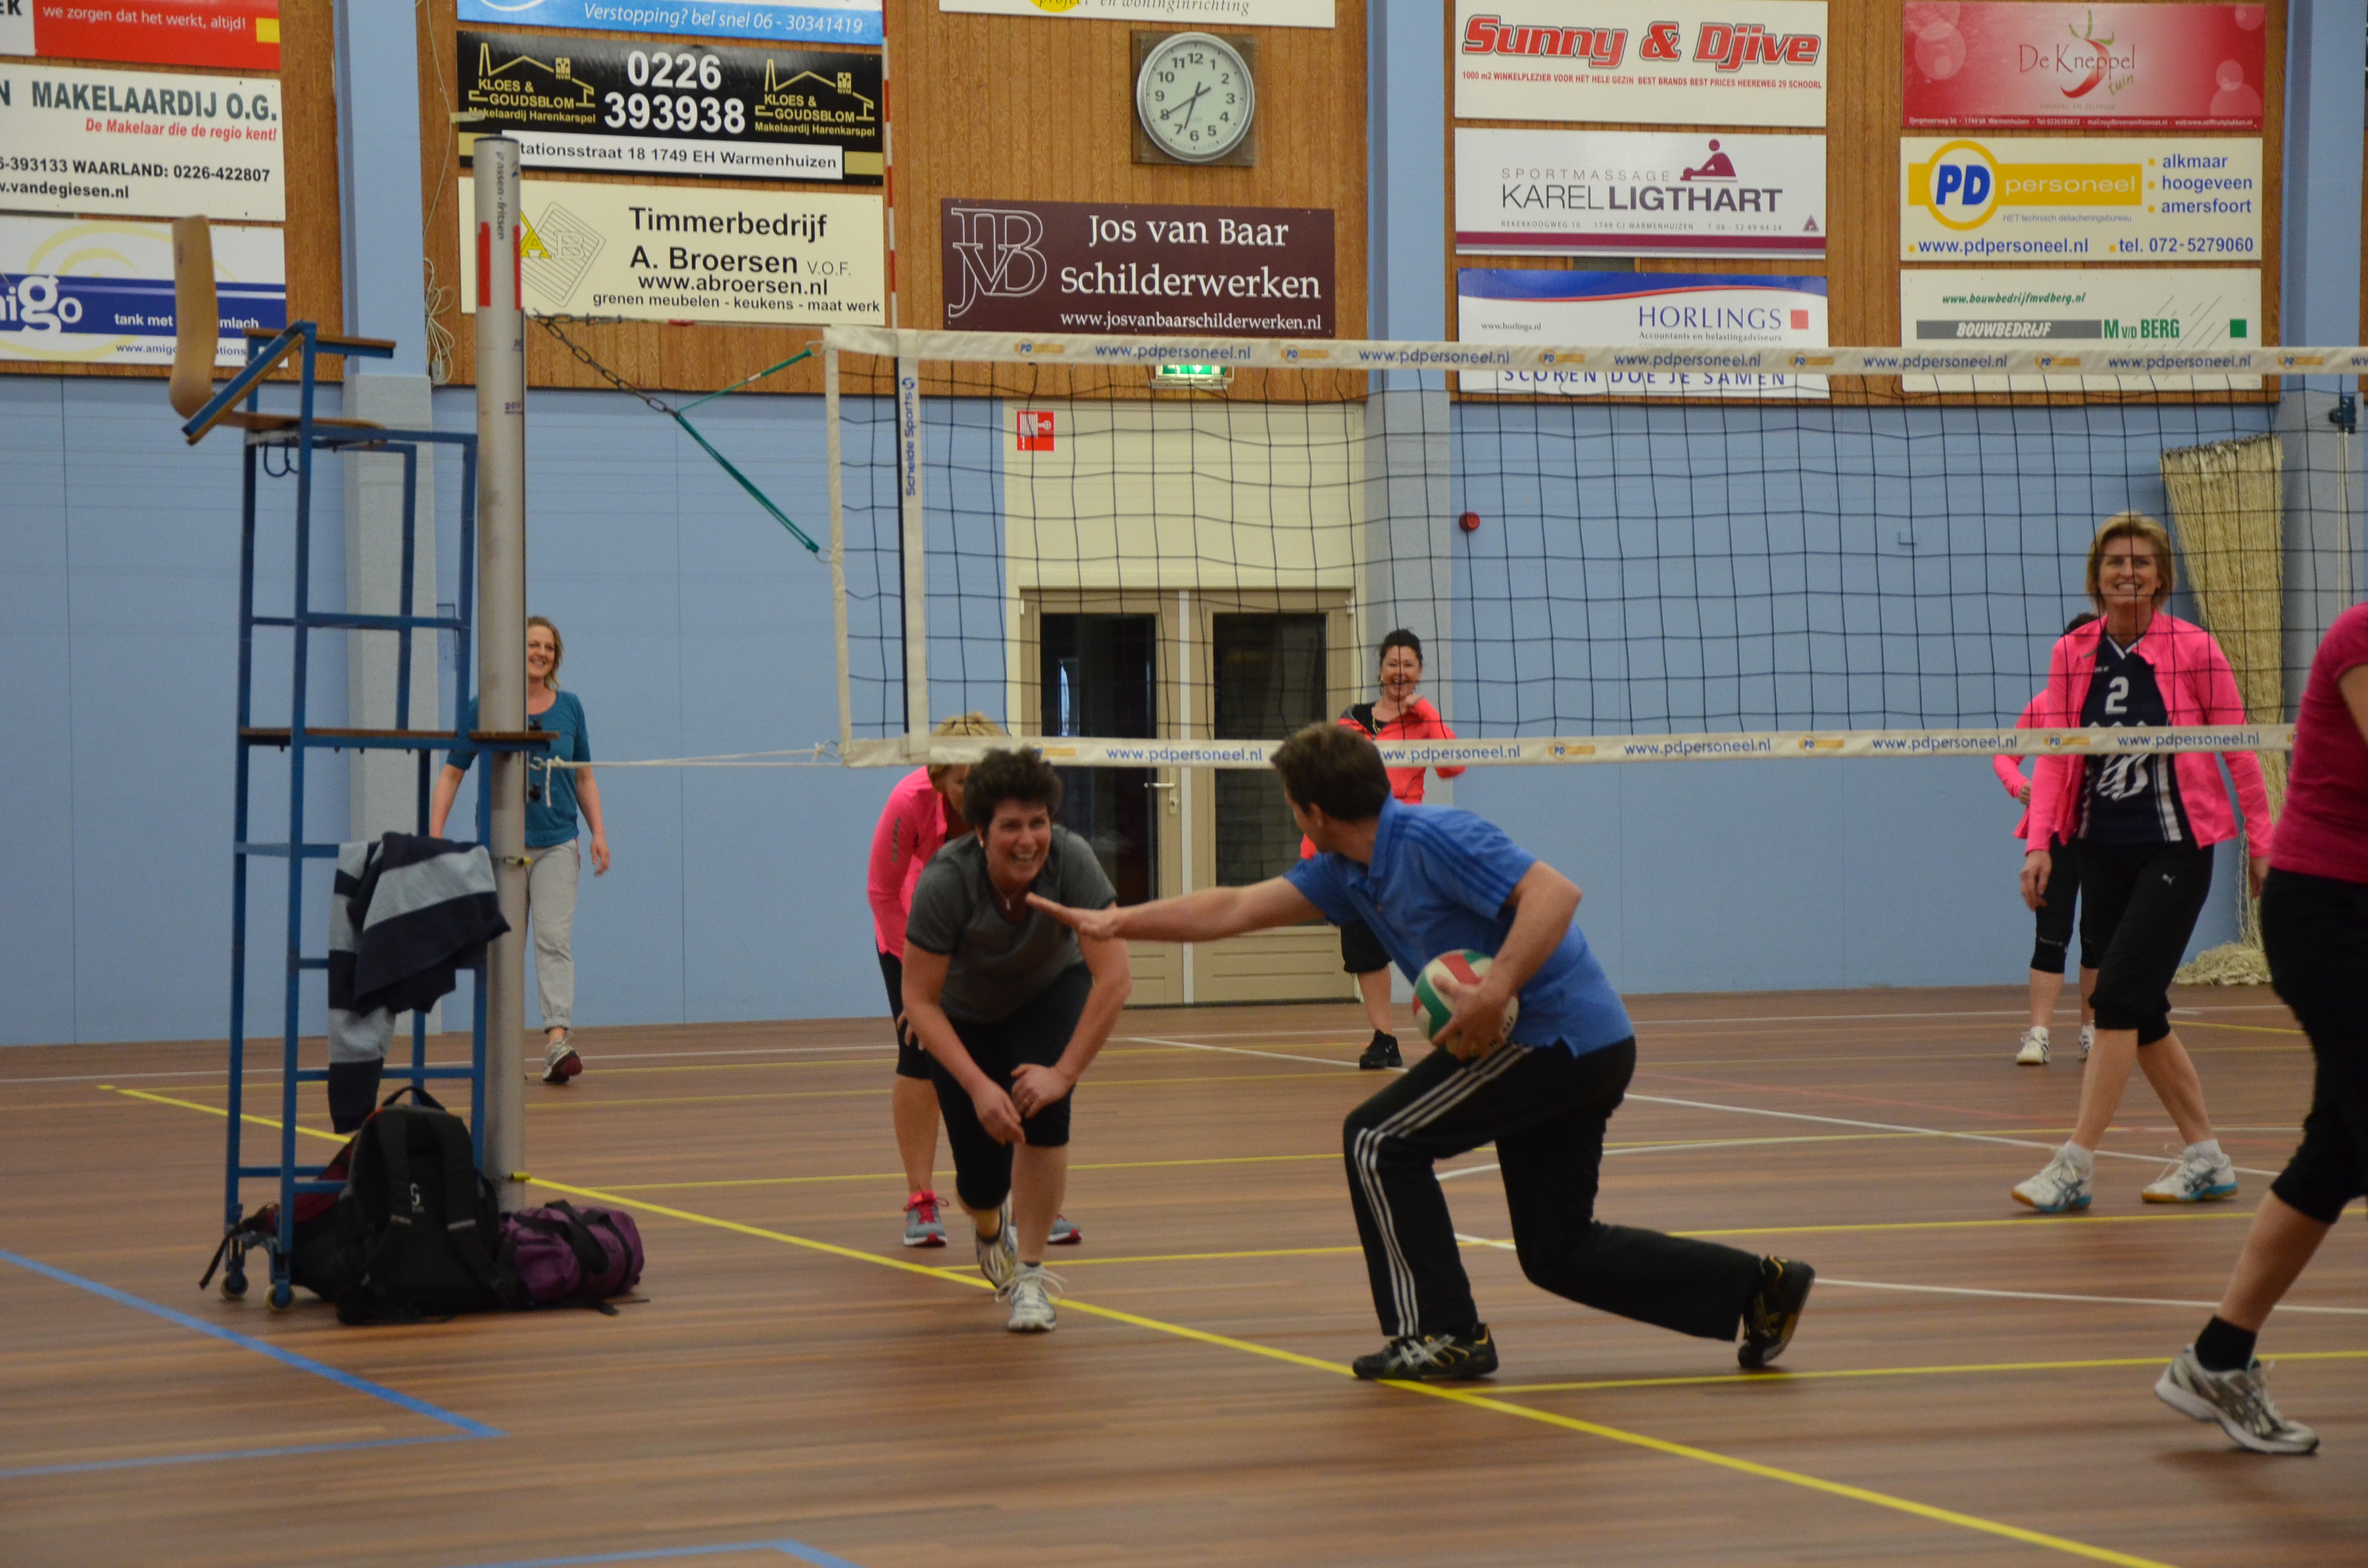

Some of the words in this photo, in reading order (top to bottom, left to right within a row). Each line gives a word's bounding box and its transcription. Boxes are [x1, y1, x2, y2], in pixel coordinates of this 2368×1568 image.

[43, 6, 63, 17] we
[67, 8, 112, 23] zorgen
[117, 9, 137, 23] dat
[142, 10, 162, 24] het
[166, 13, 206, 29] werkt,
[211, 15, 245, 32] altijd!
[585, 3, 688, 28] Verstopping?
[691, 8, 716, 26] bel
[718, 11, 750, 28] snel
[753, 13, 773, 29] 06
[785, 15, 863, 33] 30341419
[1462, 13, 1629, 69] Sunny
[1639, 20, 1682, 61] &
[1693, 22, 1821, 72] Djive
[1172, 58, 1185, 69] 11
[1188, 53, 1203, 64] 12
[1210, 59, 1216, 70] 1
[2019, 44, 2049, 72] De
[2055, 43, 2135, 81] Kneppel
[627, 50, 721, 90] 0226
[1158, 71, 1175, 83] 10
[1221, 73, 1230, 85] 2
[1462, 70, 1479, 79] 1000
[1493, 72, 1552, 83] WINKELPLEZIER
[1554, 74, 1574, 83] VOOR
[1575, 74, 1590, 83] HET
[1591, 75, 1610, 84] HELE
[1612, 76, 1634, 85] GEZIN
[1638, 76, 1656, 85] BEST
[1658, 77, 1688, 86] BRANDS
[1690, 78, 1709, 86] BEST
[1710, 78, 1736, 87] PRICES
[1738, 79, 1777, 88] HEEREWEG
[1779, 79, 1787, 88] 29
[1789, 79, 1822, 88] SCHOORL
[478, 78, 520, 92] KLOES
[525, 81, 534, 93] &
[32, 81, 217, 117] MAKELAARDIJ
[226, 92, 277, 120] O.G.
[489, 93, 574, 109] GOUDSBLOM
[764, 94, 803, 106] KLOES
[808, 95, 816, 107] &
[1155, 90, 1165, 102] 9
[1225, 93, 1236, 104] 3
[530, 110, 596, 124] Harenkarspel
[604, 91, 746, 134] 393938
[775, 108, 854, 122] GOUDSBLOM
[1160, 109, 1170, 120] 8
[1219, 111, 1230, 122] 4
[85, 118, 102, 131] De
[107, 118, 165, 135] Makelaar
[169, 122, 187, 136] die
[192, 123, 206, 137] de
[210, 126, 242, 142] regio
[246, 127, 277, 141] kent!
[755, 122, 809, 136] Makelaardij
[812, 124, 875, 138] Harenkarspel
[1174, 124, 1183, 135] 7
[1190, 130, 1199, 142] 6
[1207, 125, 1217, 136] 5
[628, 147, 645, 159] 18
[652, 149, 687, 161] 1749
[693, 149, 715, 163] EH
[720, 151, 837, 168] Warmenhuizen
[2162, 154, 2228, 168] alkmaar
[73, 159, 169, 177] WAARLAND:
[174, 165, 270, 182] 0226-422807
[1502, 168, 1670, 182] SPORTMASSAGE
[1936, 165, 1991, 205] PD
[2005, 175, 2135, 196] personeel
[2162, 175, 2253, 193] hoogeveen
[2161, 198, 2252, 213] amersfoort
[629, 206, 827, 243] Timmerbedrijf
[1501, 220, 1568, 229] REKERKOOGWEG
[1629, 222, 1694, 231] WARMENHUIZEN
[2003, 213, 2020, 222] HET
[2021, 213, 2057, 222] technisch
[2059, 213, 2132, 223] detacheringsbureau
[1089, 215, 1137, 247] Jos
[1146, 220, 1209, 244] van
[1218, 218, 1289, 247] Baar
[1918, 238, 2089, 256] www.pdpersoneel.nl
[2118, 238, 2143, 252] tel.
[630, 245, 658, 268] A.
[670, 246, 798, 274] Broersen
[807, 260, 851, 276] V.O.F.
[638, 274, 828, 295] www.abroersen.nl
[1060, 261, 1322, 299] Schilderwerken
[593, 293, 644, 307] grenen
[649, 294, 719, 307] meubelen
[734, 296, 794, 310] keukens
[807, 299, 842, 311] maat
[846, 300, 880, 313] werk
[1943, 292, 2086, 306] www.bouwbedrijfmvdberg.nl
[115, 313, 144, 326] tank
[147, 314, 174, 327] met
[1060, 310, 1322, 332] www.josvanbaarschilderwerken.nl
[1481, 322, 1542, 332] www.horlings.nl
[1639, 306, 1782, 330] HORLINGS
[1639, 331, 1690, 341] Accountants
[1706, 332, 1782, 343] belastingadviseurs
[1956, 322, 2052, 338] BOUWBEDRIJF
[2104, 319, 2119, 339] M
[2141, 319, 2180, 339] BERG
[1020, 344, 1032, 352] PD
[1095, 344, 1251, 360] www.pdpersoneel.nl
[1285, 349, 1298, 359] PD
[1358, 348, 1510, 364] www.pdpersoneel.nl
[1543, 353, 1555, 363] PD
[1614, 352, 1761, 368] www.pdpersoneel.nl
[1794, 356, 1806, 365] PD
[1863, 354, 2007, 370] www.pdpersoneel.nl
[2040, 358, 2052, 366] PD
[2109, 354, 2252, 370] www.pdpersoneel.nl
[2283, 356, 2295, 365] PD
[902, 392, 914, 437] Sports
[906, 440, 916, 496] Schelde
[2105, 676, 2128, 714] 2
[1106, 747, 1262, 764] www.pdpersoneel.nl
[1554, 746, 1565, 755] PD
[1624, 738, 1771, 756] www.pdpersoneel.nl
[1804, 740, 1814, 748] PD
[1873, 735, 2018, 751] www.pdpersoneel.nl
[2050, 737, 2061, 746] PD
[2117, 731, 2260, 749] www.pdpersoneel.nl
